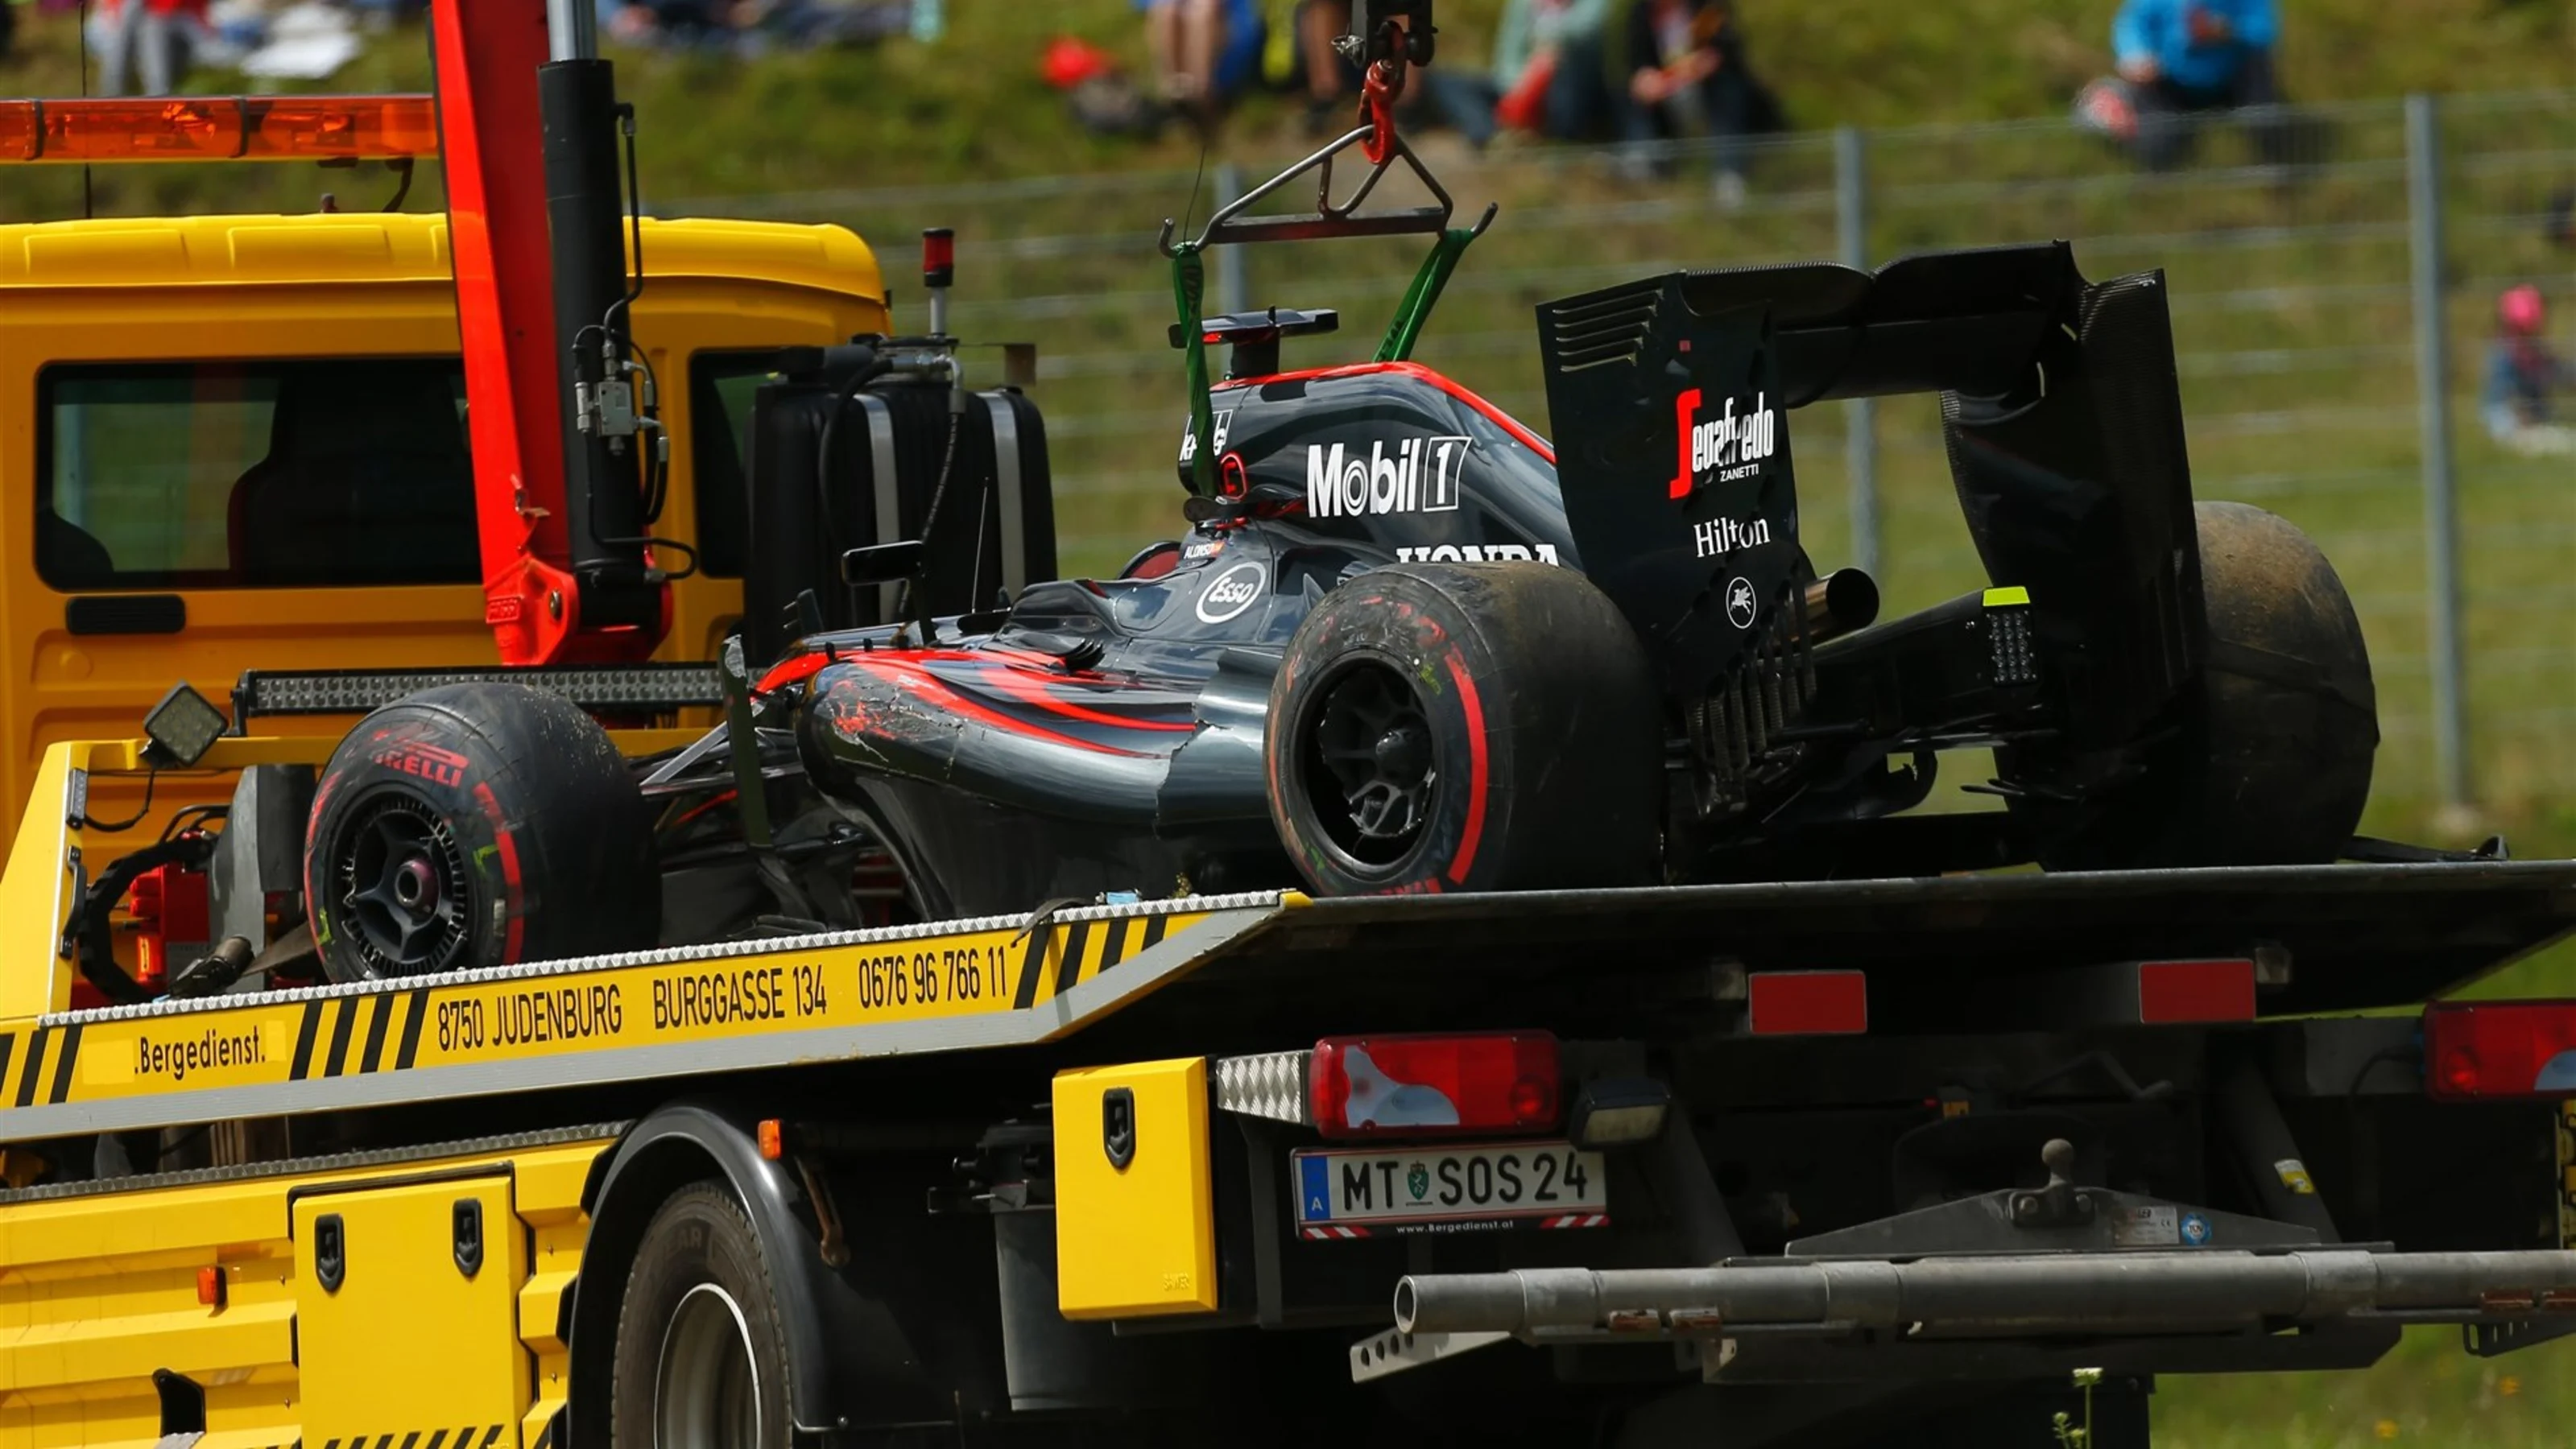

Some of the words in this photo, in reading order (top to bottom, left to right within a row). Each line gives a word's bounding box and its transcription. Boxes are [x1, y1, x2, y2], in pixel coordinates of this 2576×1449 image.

[1179, 428, 1226, 461] KPG
[1306, 439, 1421, 518] Mobil
[1719, 463, 1759, 483] ZANETTI
[1693, 517, 1771, 558] Hilton
[374, 742, 469, 788] RELLI
[438, 998, 485, 1051] 8750
[491, 984, 622, 1047] JUDENBURG
[653, 968, 785, 1030] BURGGASSE
[792, 965, 827, 1016] 134
[859, 955, 908, 1009] 0676
[913, 952, 937, 1004] 96
[943, 948, 980, 1001] 766
[988, 946, 1006, 997] 11
[1342, 1160, 1400, 1212] MT
[1437, 1153, 1523, 1207] SOS
[1532, 1151, 1587, 1202] 24
[1311, 1196, 1323, 1212] A
[1396, 1220, 1514, 1234] www.Bergedienst.at
